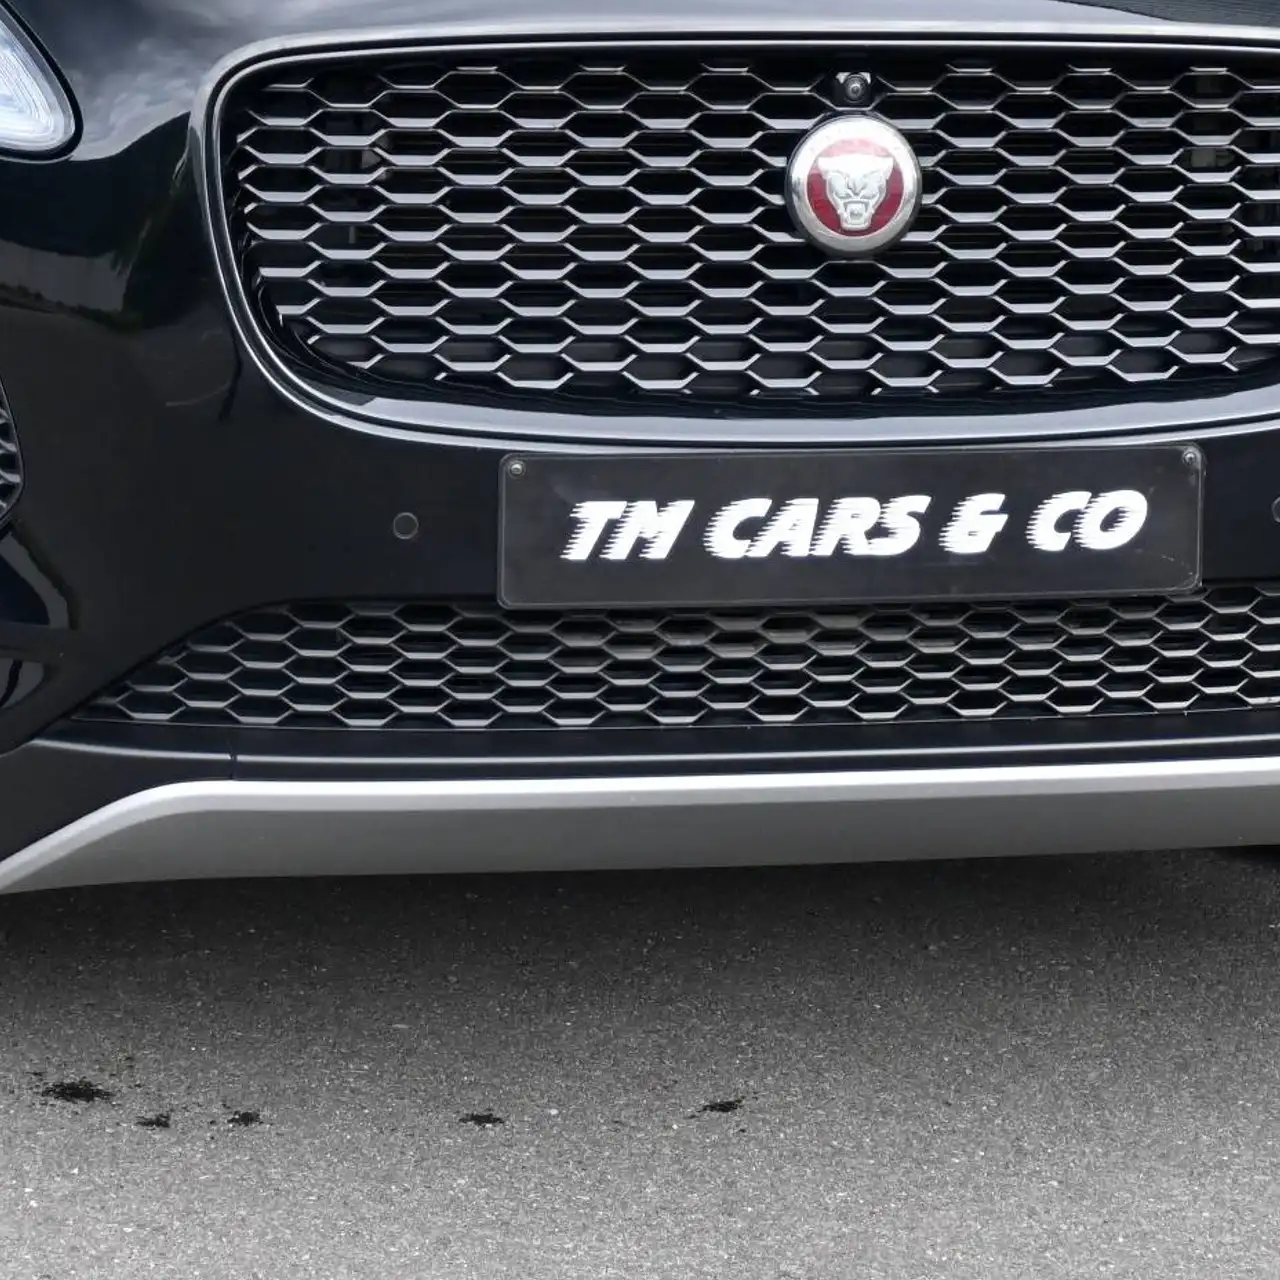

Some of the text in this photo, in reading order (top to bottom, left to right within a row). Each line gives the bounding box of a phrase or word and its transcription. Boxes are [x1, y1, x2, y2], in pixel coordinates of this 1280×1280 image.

[560, 489, 1149, 561] TM CARS & CO
